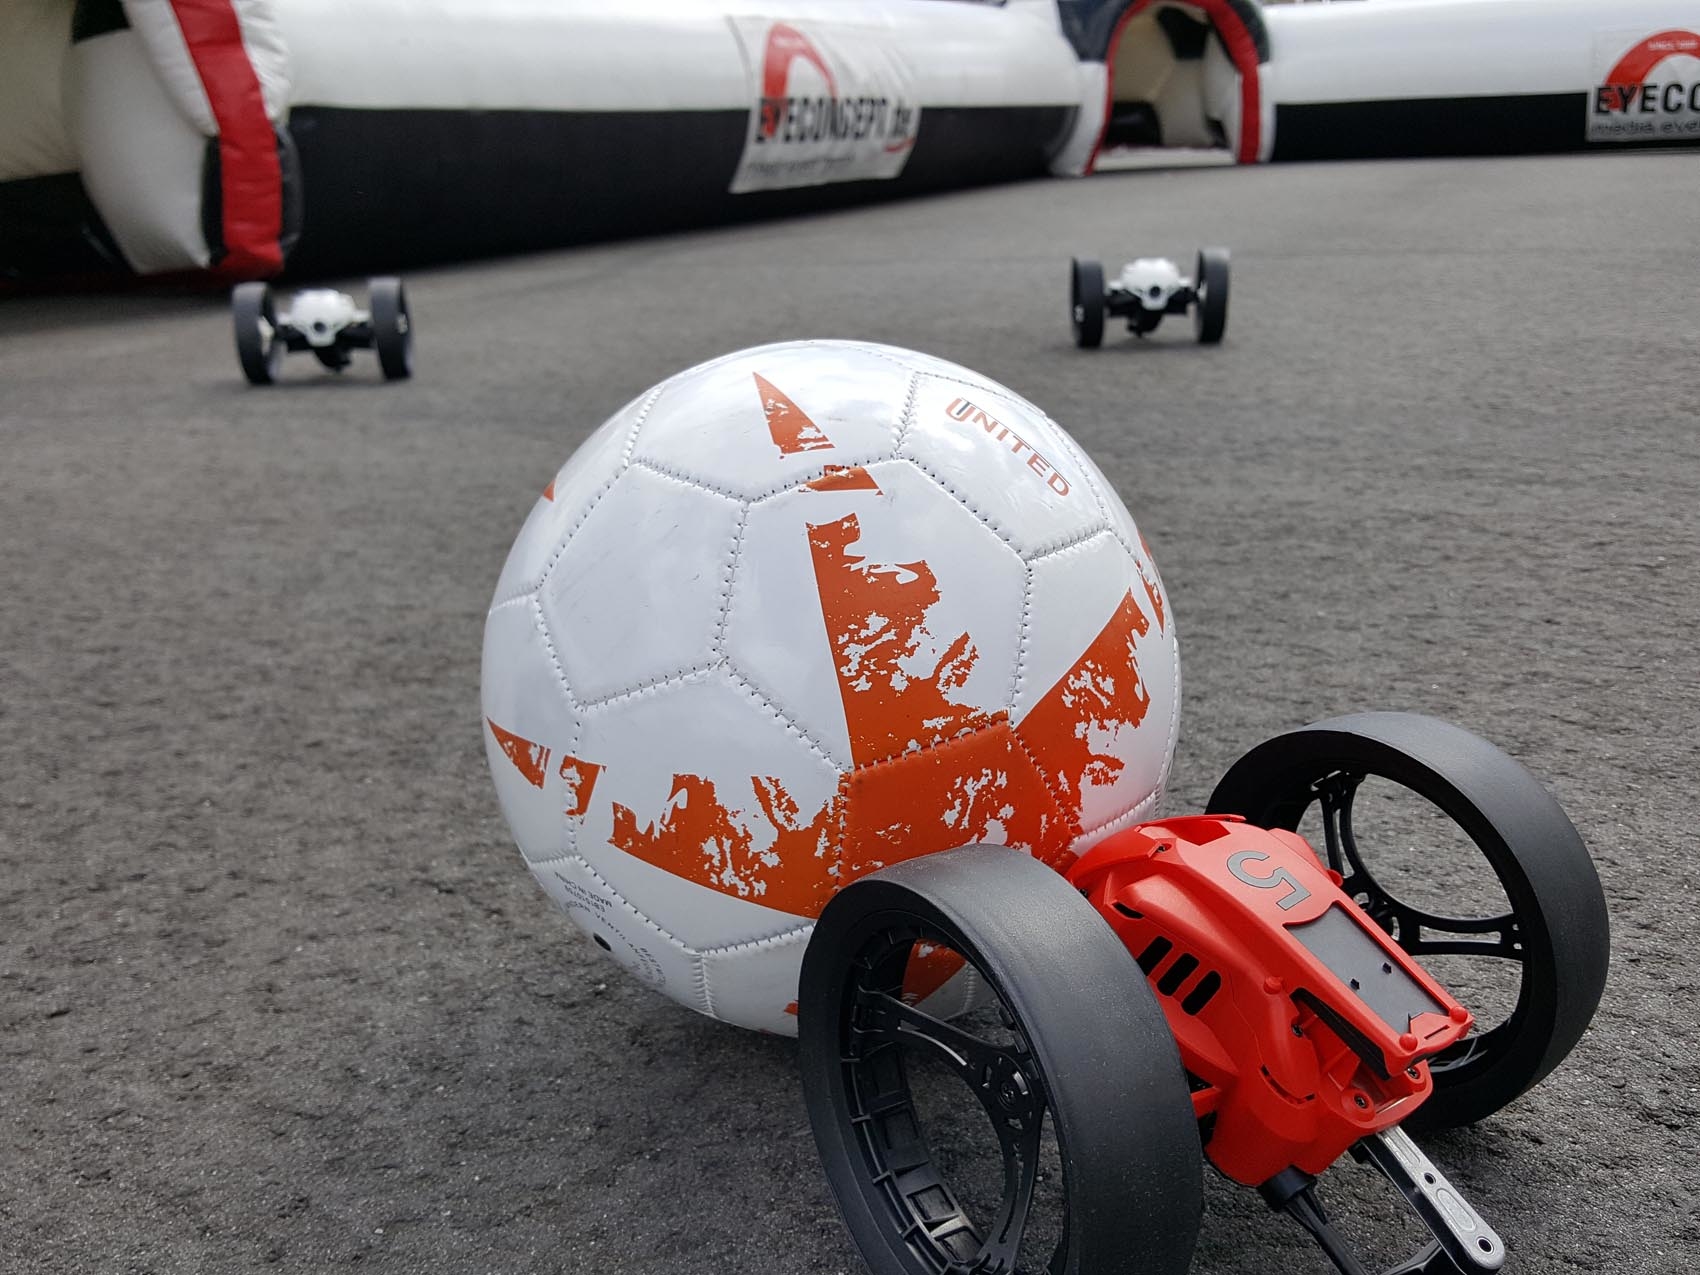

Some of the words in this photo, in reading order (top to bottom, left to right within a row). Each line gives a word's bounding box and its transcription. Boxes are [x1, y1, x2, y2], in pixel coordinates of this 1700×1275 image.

[1662, 120, 1700, 135] eve
[945, 398, 1070, 497] UNITED
[587, 890, 613, 908] MADE
[1226, 849, 1312, 911] 5
